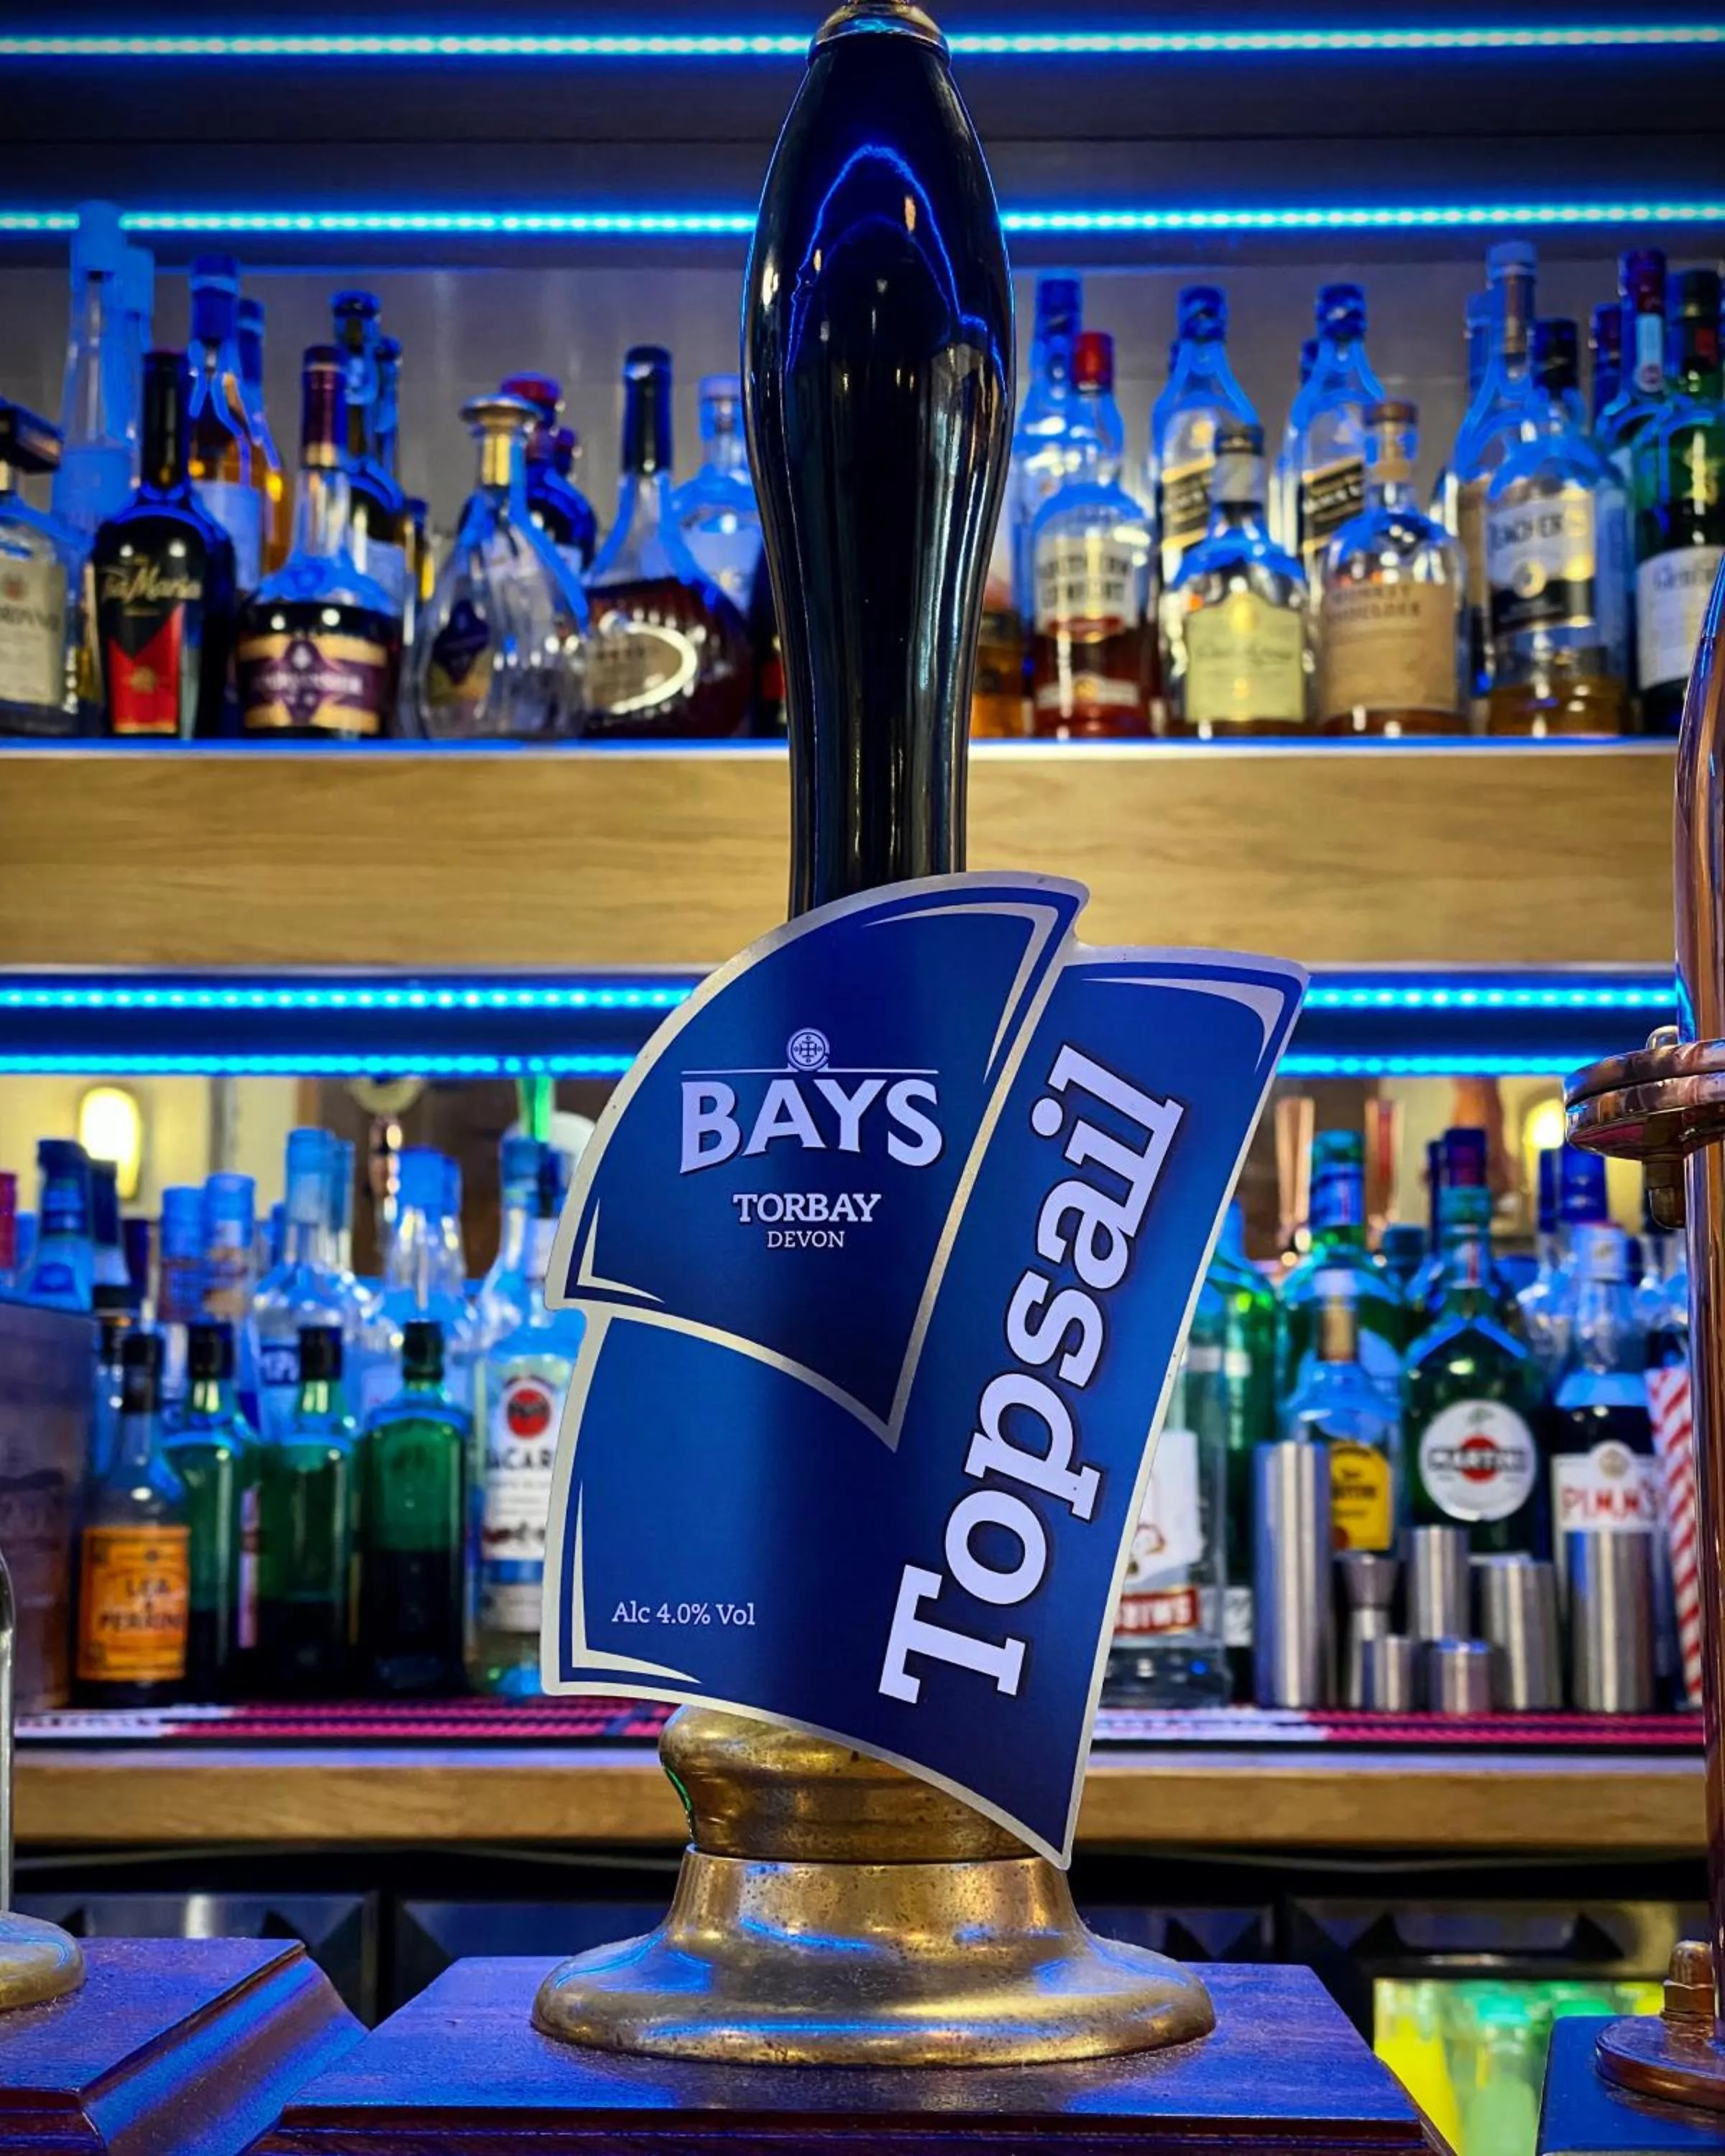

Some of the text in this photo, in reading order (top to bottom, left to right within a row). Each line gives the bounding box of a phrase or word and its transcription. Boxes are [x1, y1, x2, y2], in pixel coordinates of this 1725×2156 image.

[679, 1078, 943, 1174] BAYS
[732, 1193, 882, 1223] TORBAY
[766, 1230, 846, 1248] DEVON
[878, 1044, 1184, 1705] Topsail
[611, 1600, 756, 1626] Alc 4.0% Vol
